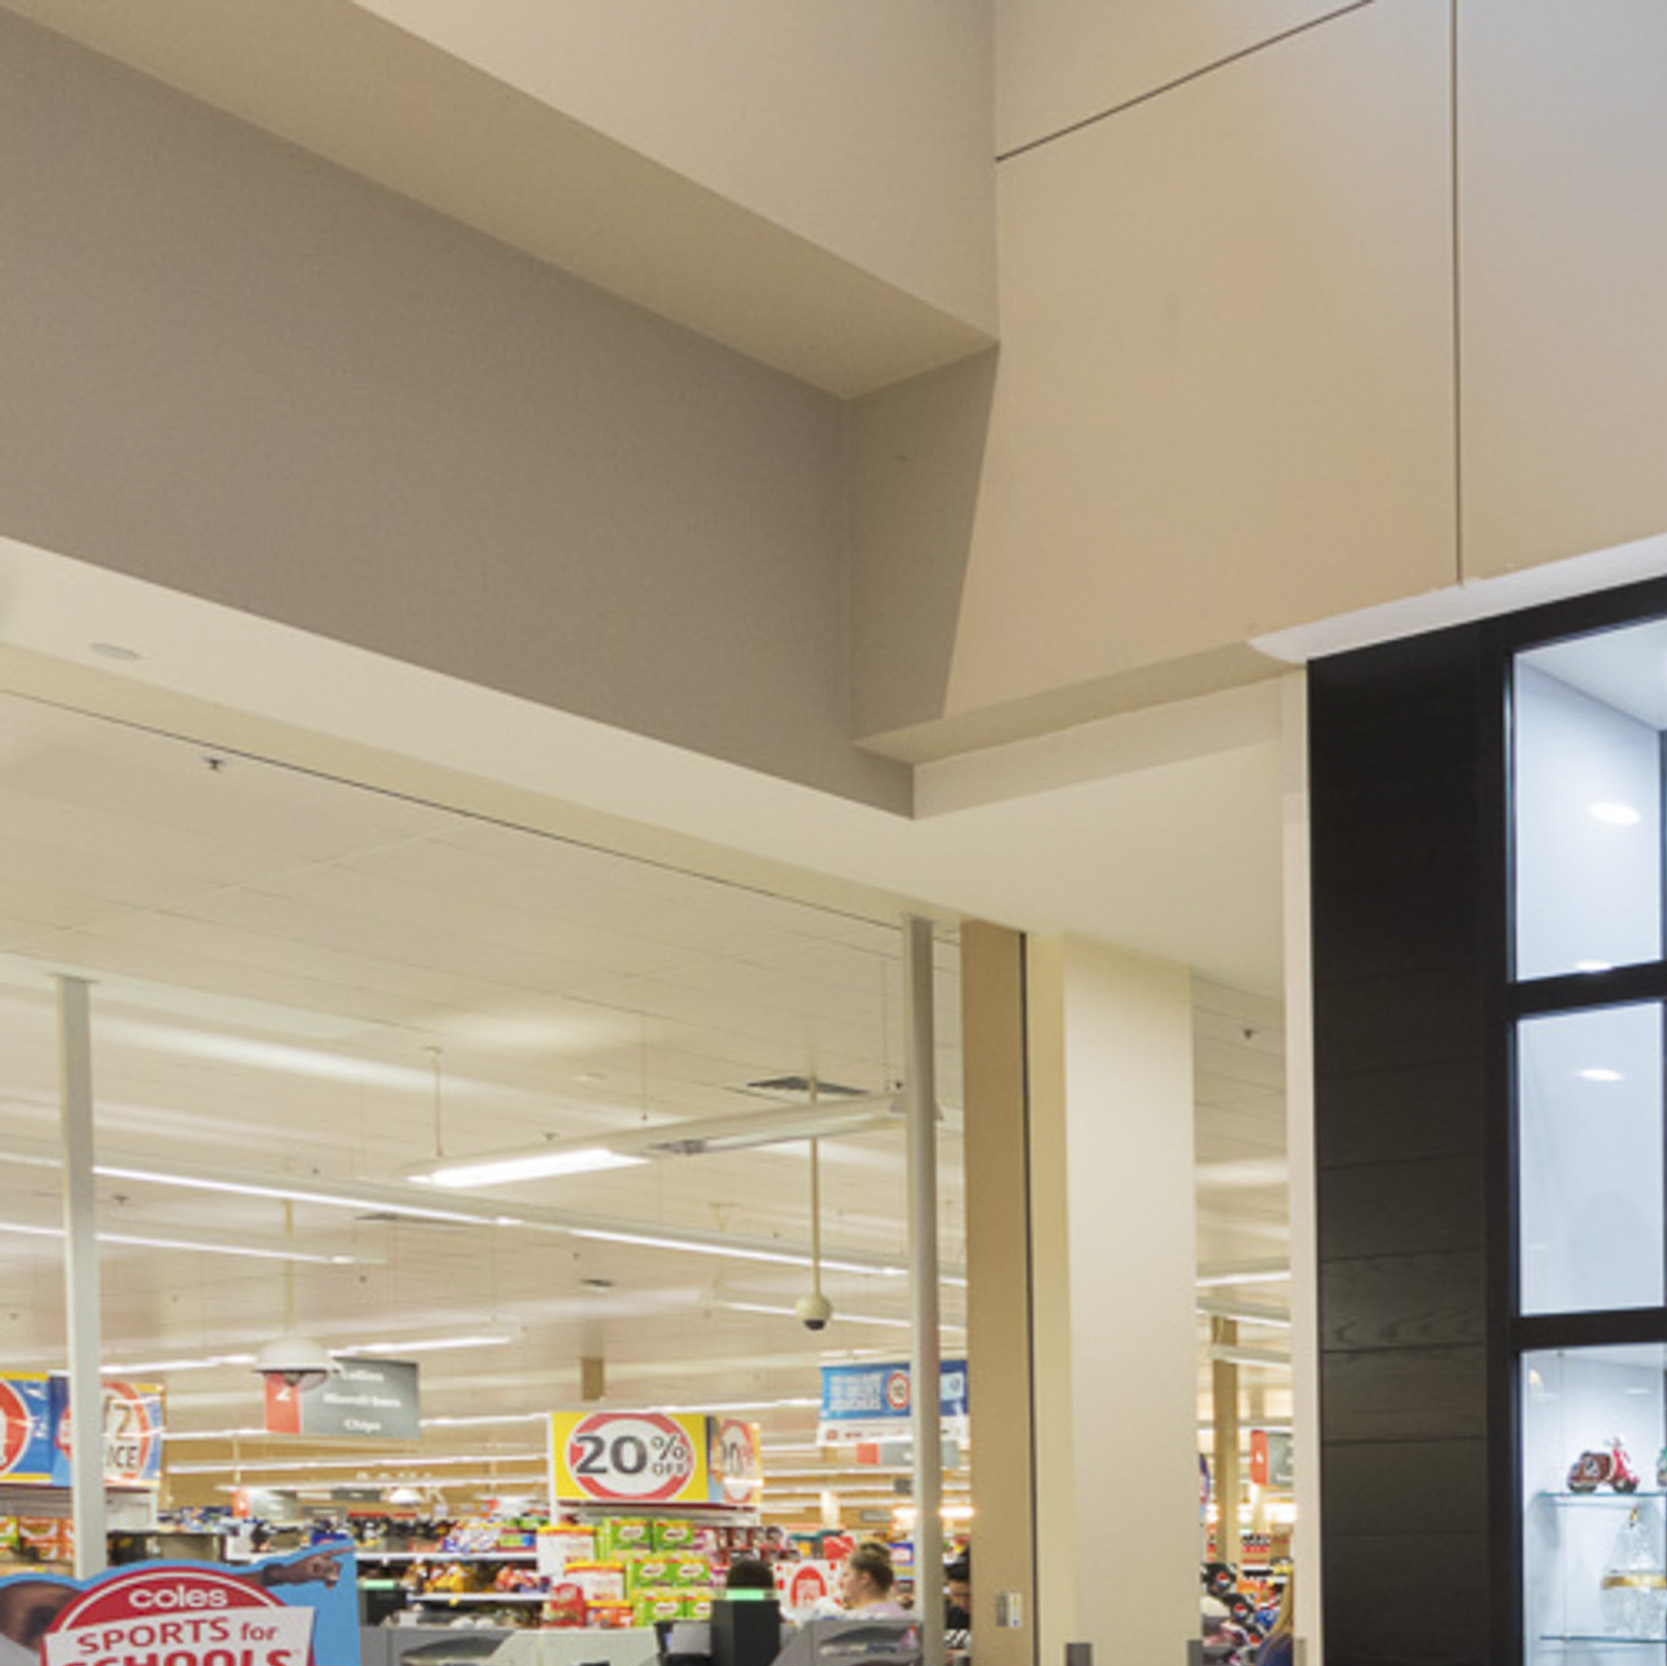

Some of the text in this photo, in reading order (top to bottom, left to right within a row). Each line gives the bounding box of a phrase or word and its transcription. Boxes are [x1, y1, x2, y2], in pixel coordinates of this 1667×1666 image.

[129, 1585, 228, 1609] coles
[78, 1617, 277, 1656] SPORTS for
